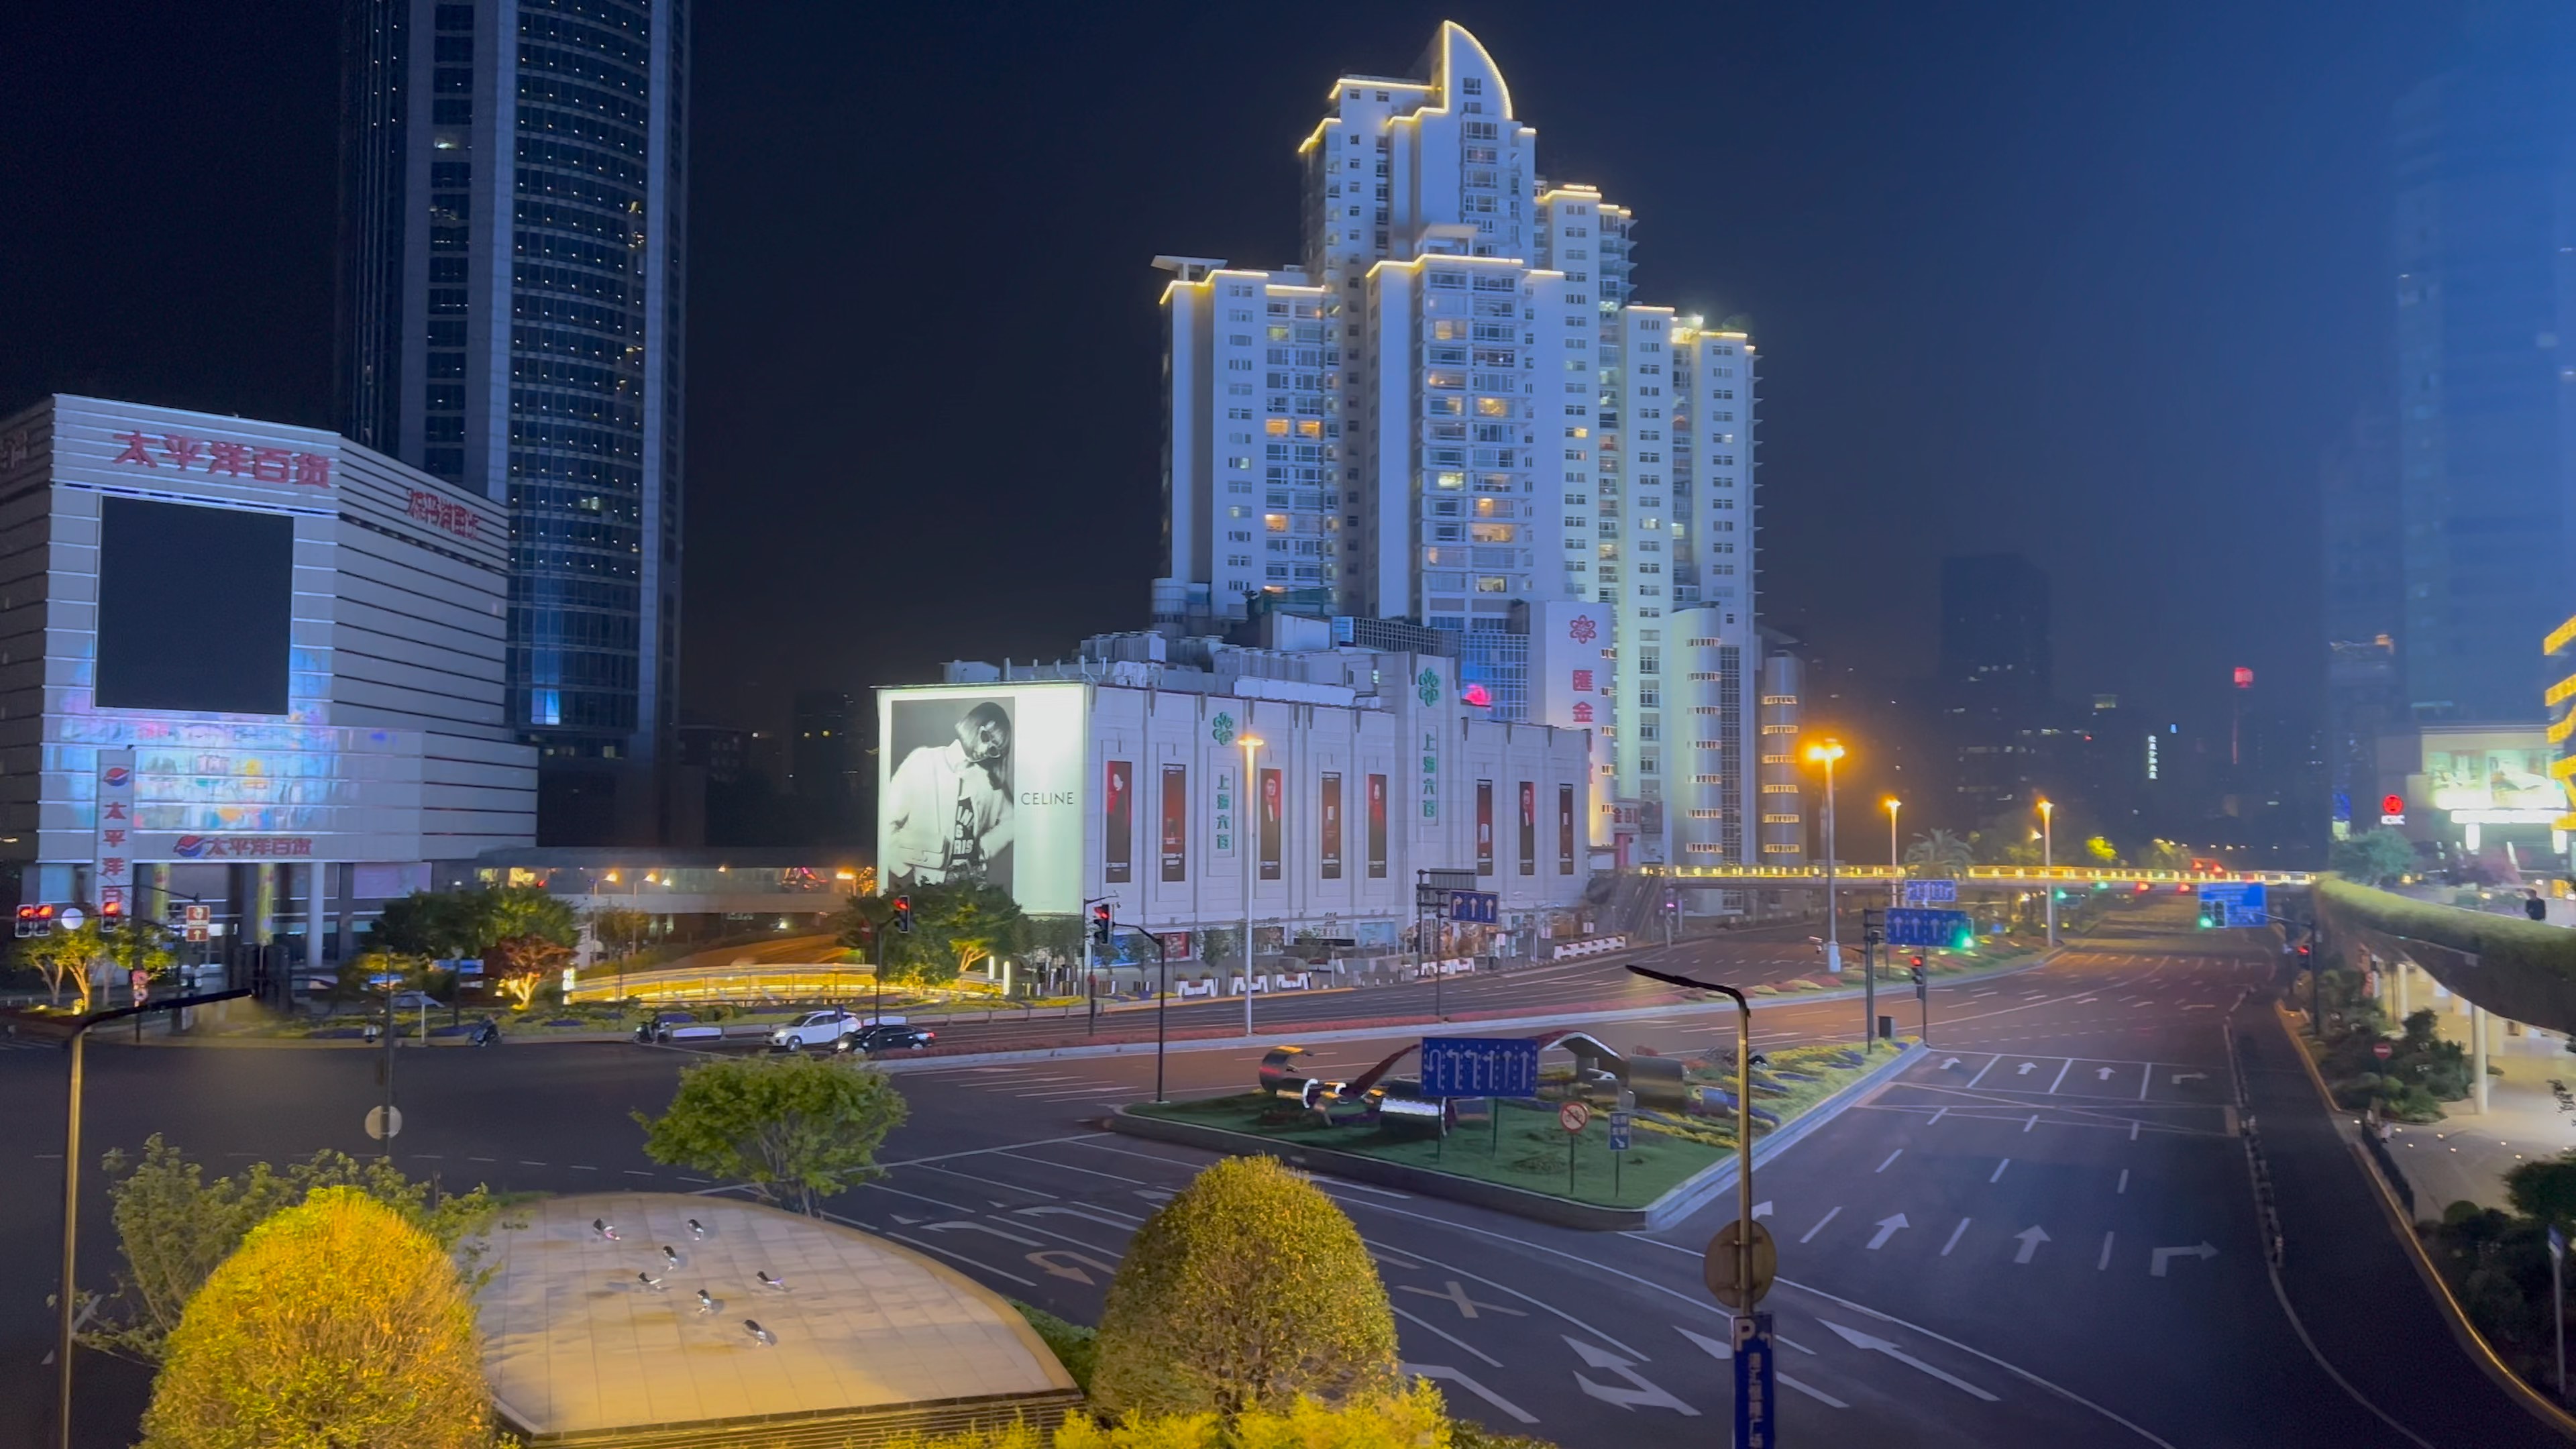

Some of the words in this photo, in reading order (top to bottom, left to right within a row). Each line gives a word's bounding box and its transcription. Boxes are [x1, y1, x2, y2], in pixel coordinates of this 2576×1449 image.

[112, 430, 331, 488] 太平洋百货
[1020, 792, 1074, 805] CELINE
[1734, 1318, 1756, 1352] P
